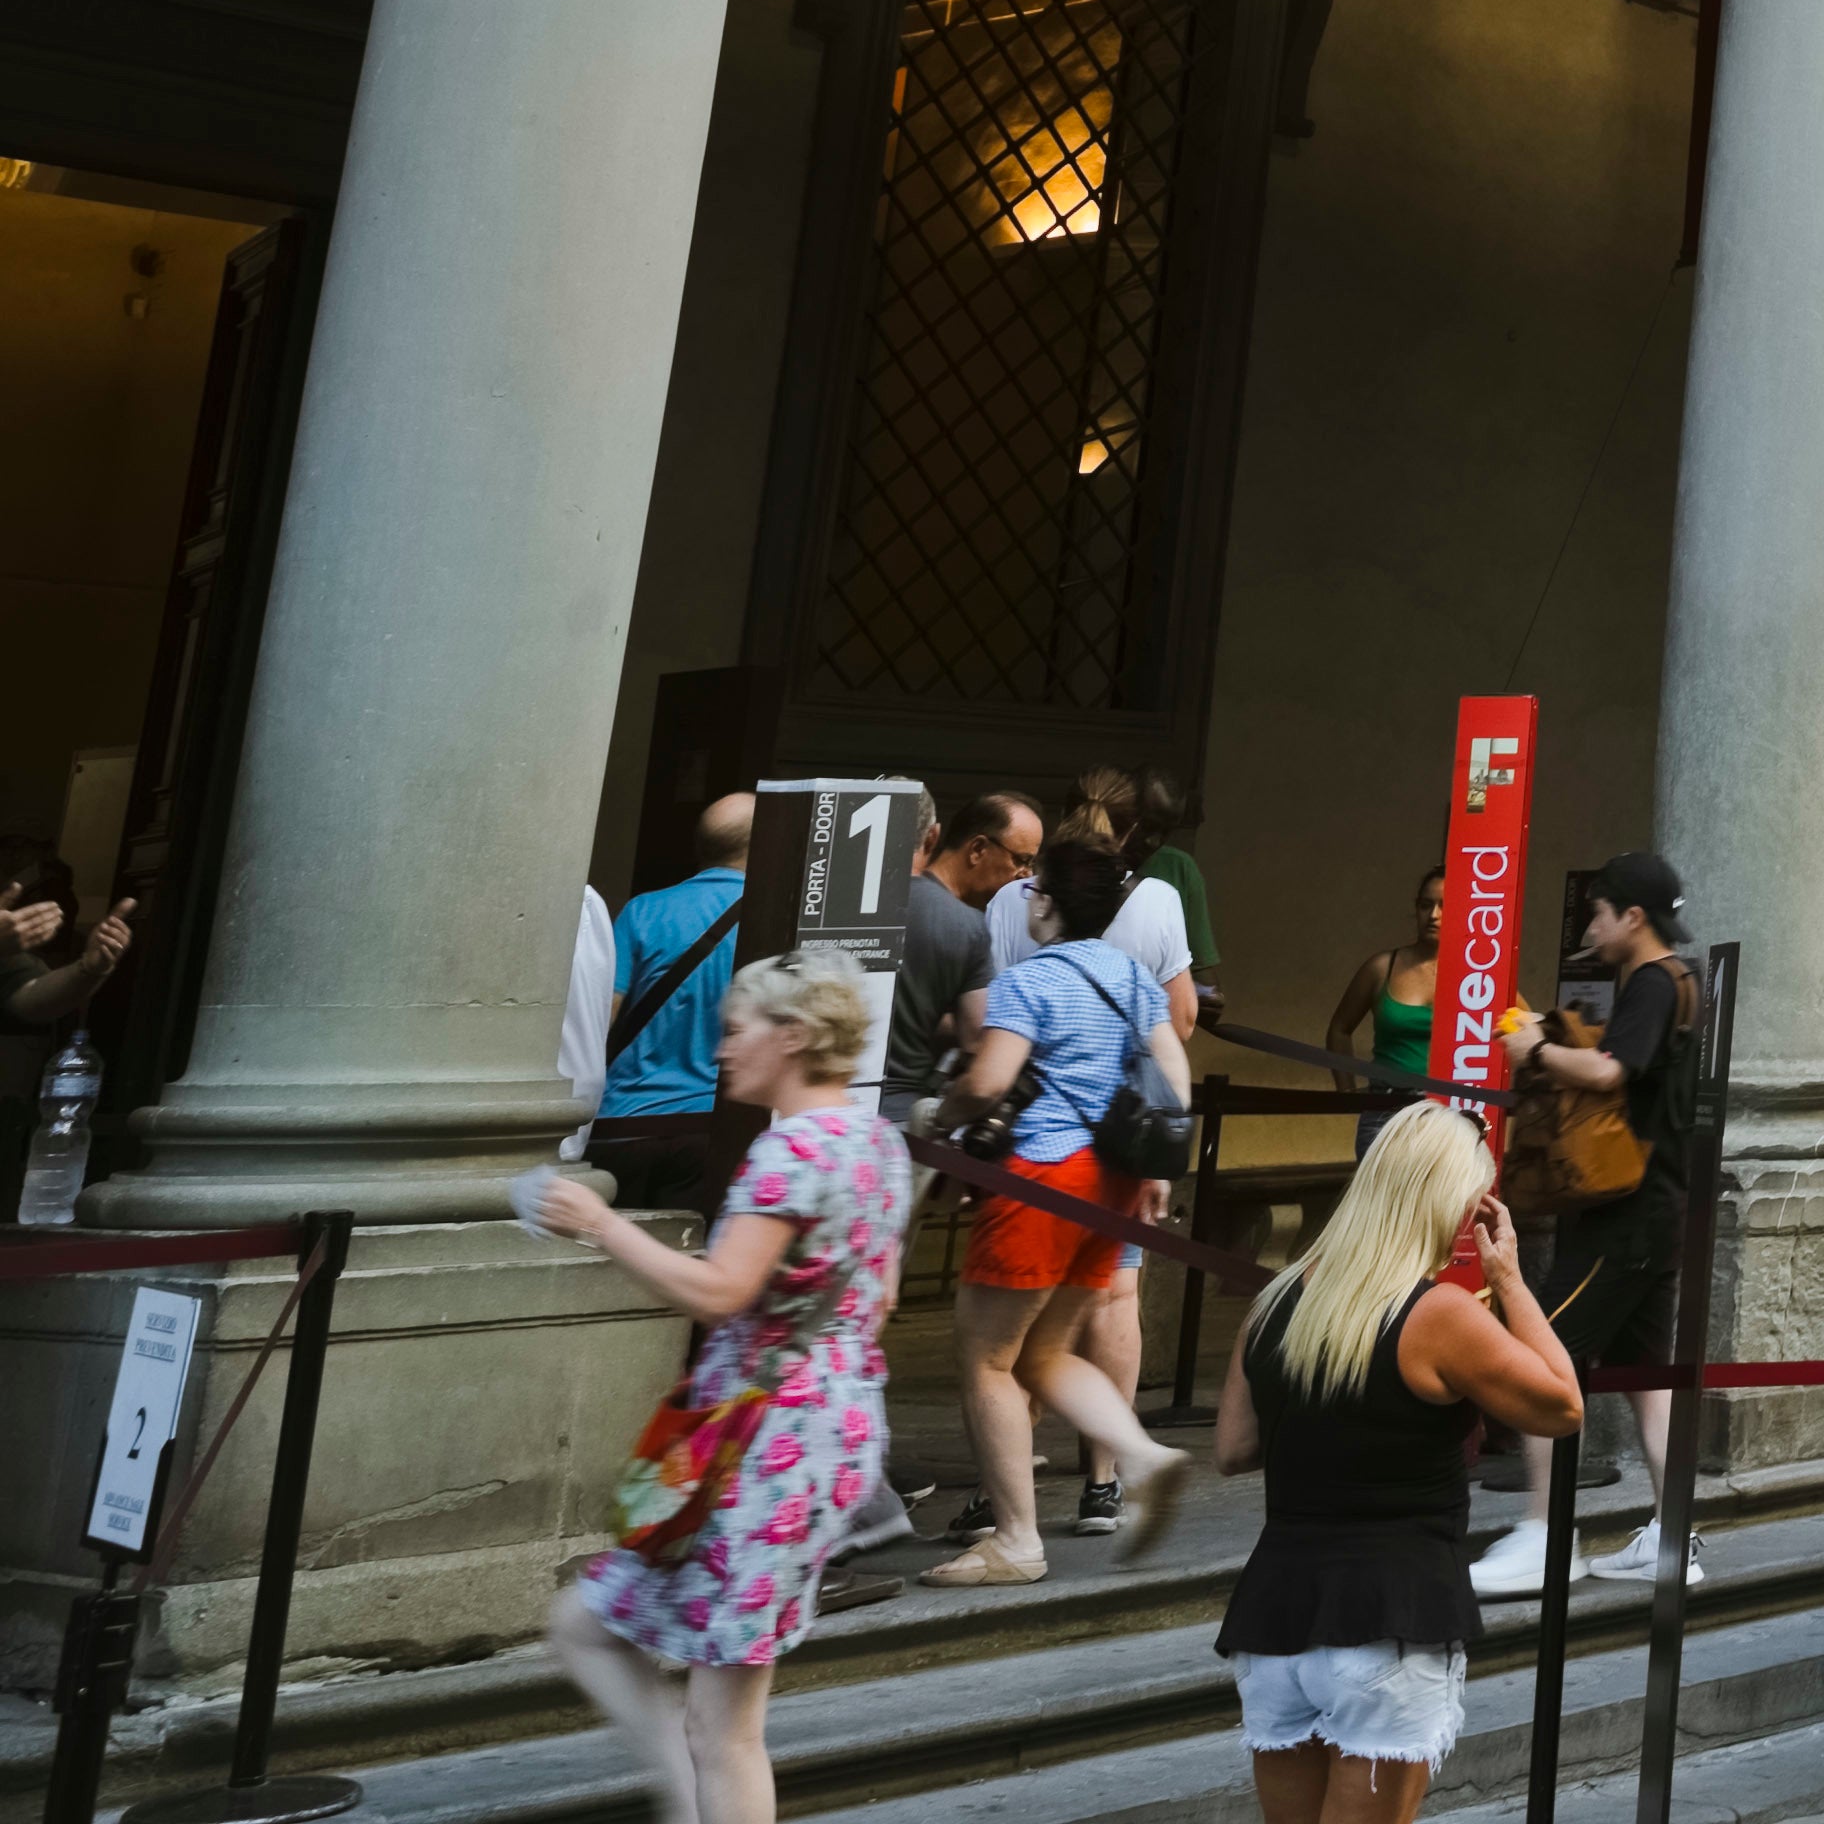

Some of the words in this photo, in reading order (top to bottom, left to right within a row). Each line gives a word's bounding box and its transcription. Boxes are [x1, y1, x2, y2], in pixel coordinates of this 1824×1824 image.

[814, 792, 836, 843] DOOR
[849, 794, 891, 914] 1
[804, 858, 828, 916] PORTA
[127, 1406, 147, 1460] 2
